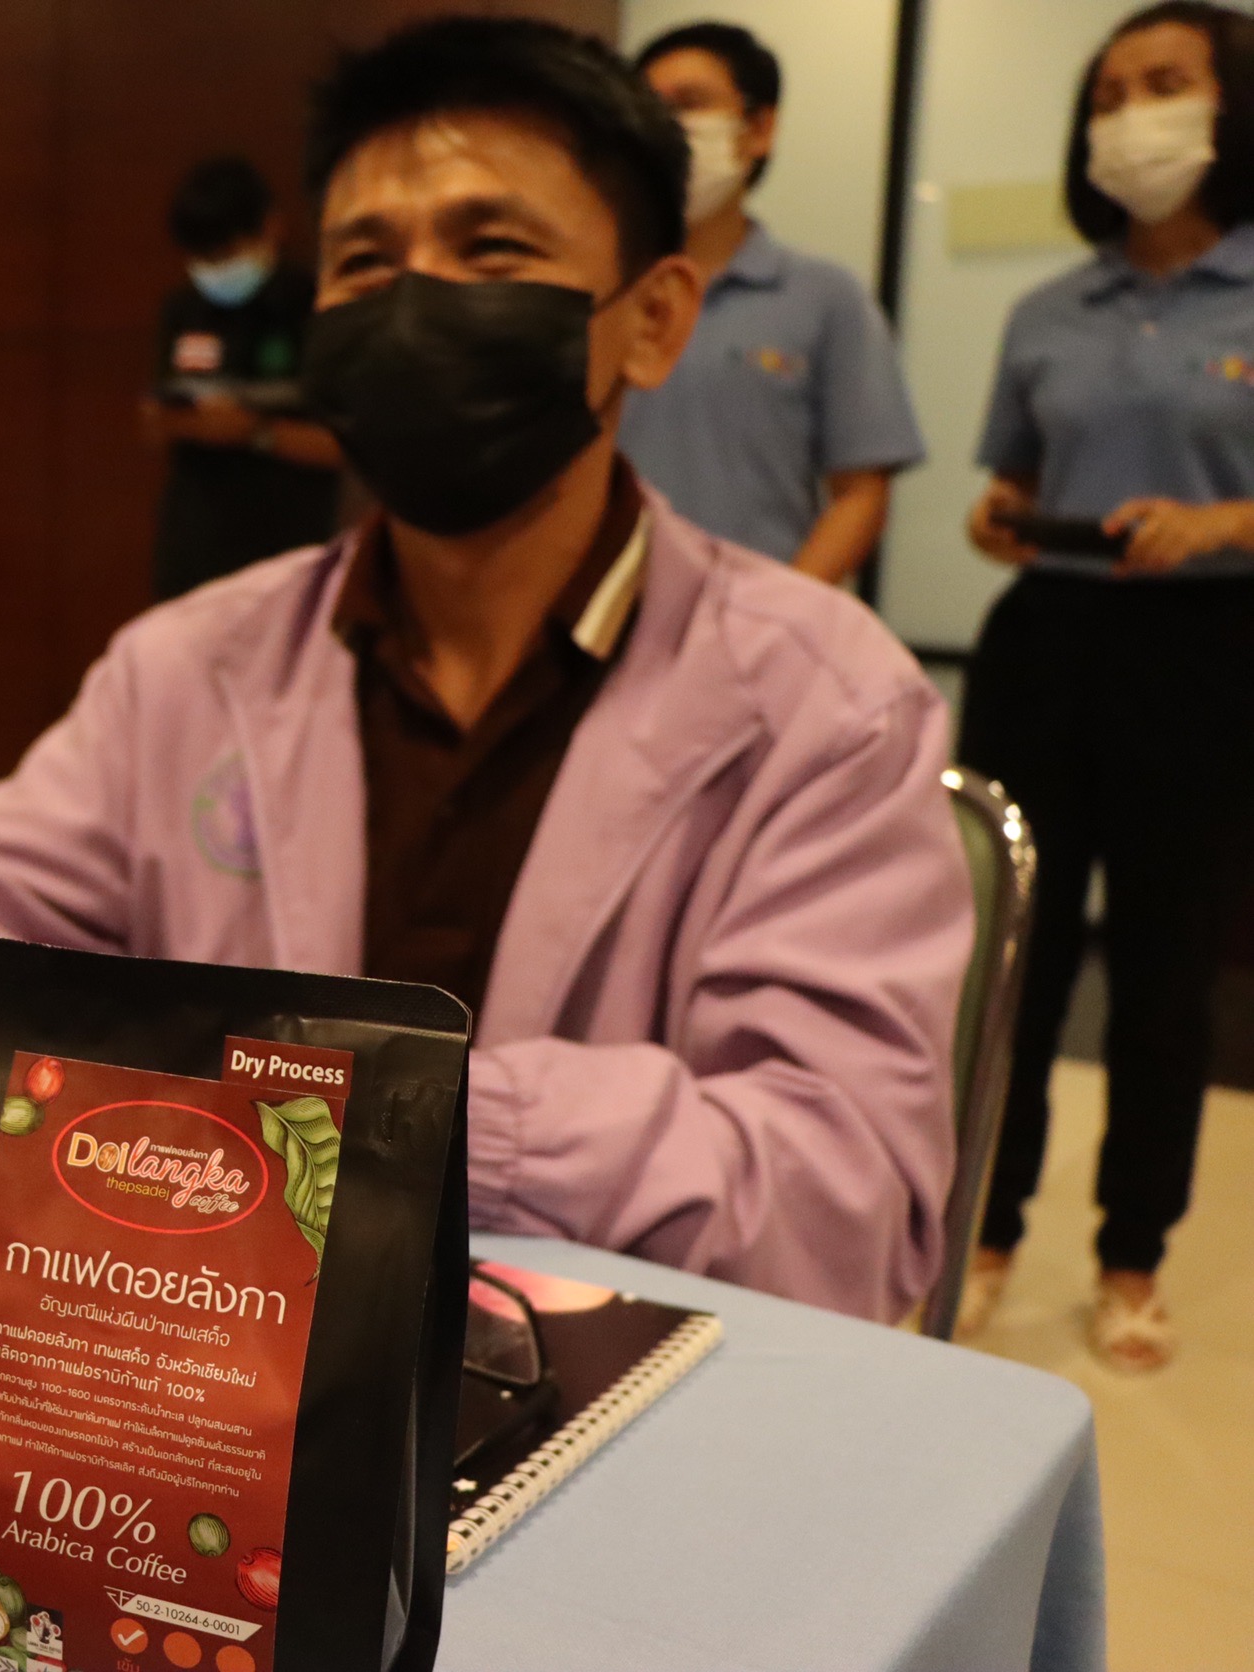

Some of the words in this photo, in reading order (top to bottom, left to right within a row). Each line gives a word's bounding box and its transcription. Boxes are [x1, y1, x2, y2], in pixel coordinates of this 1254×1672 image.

[230, 1049, 265, 1079] Dry
[268, 1054, 345, 1085] Process
[106, 1176, 170, 1201] thepsadej
[189, 1193, 240, 1214] coffee
[5, 1241, 286, 1325] กาแฟดอยลังกา
[39, 1294, 231, 1347] อัญมณีแห่งผืนป่าเทพเสด็จ
[93, 1343, 150, 1366] เทพเสด็จ
[156, 1352, 257, 1388] จังหวัดเชียงใหม่
[41, 1382, 91, 1400] 1100-1600
[94, 1393, 185, 1422] เมตรจากระดับน้ำทะเล
[188, 1414, 253, 1437] ปลูกผสมผสาน
[166, 1382, 206, 1403] 100%
[207, 1459, 262, 1482] ที่สะสมอยู่ใน
[12, 1470, 156, 1545] 100%
[0, 1520, 95, 1563] Arabica
[106, 1546, 188, 1586] Coffee
[135, 1599, 241, 1636] 50-2-10264-6-0001
